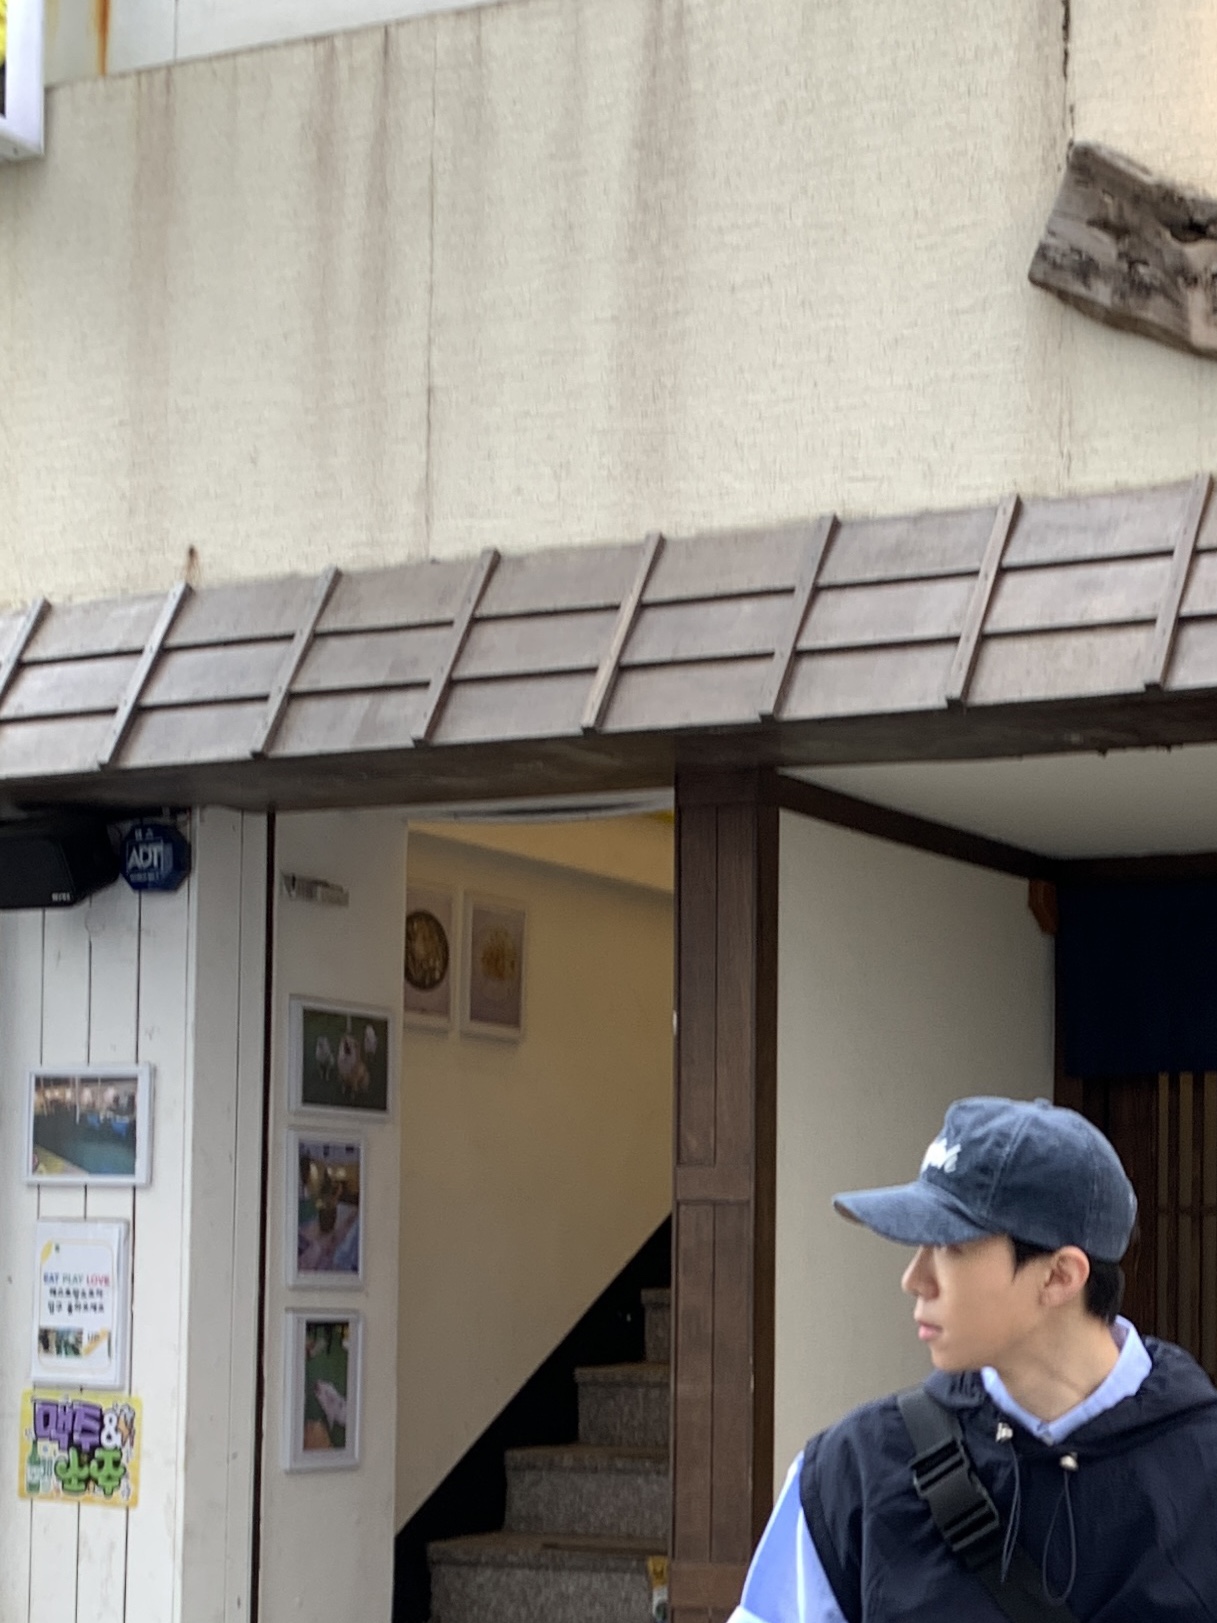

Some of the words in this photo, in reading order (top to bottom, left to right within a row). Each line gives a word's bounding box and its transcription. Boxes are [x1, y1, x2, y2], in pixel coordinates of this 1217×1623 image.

[127, 841, 164, 870] ADT
[86, 1274, 110, 1288] LOVE
[54, 1445, 128, 1497] 소주
